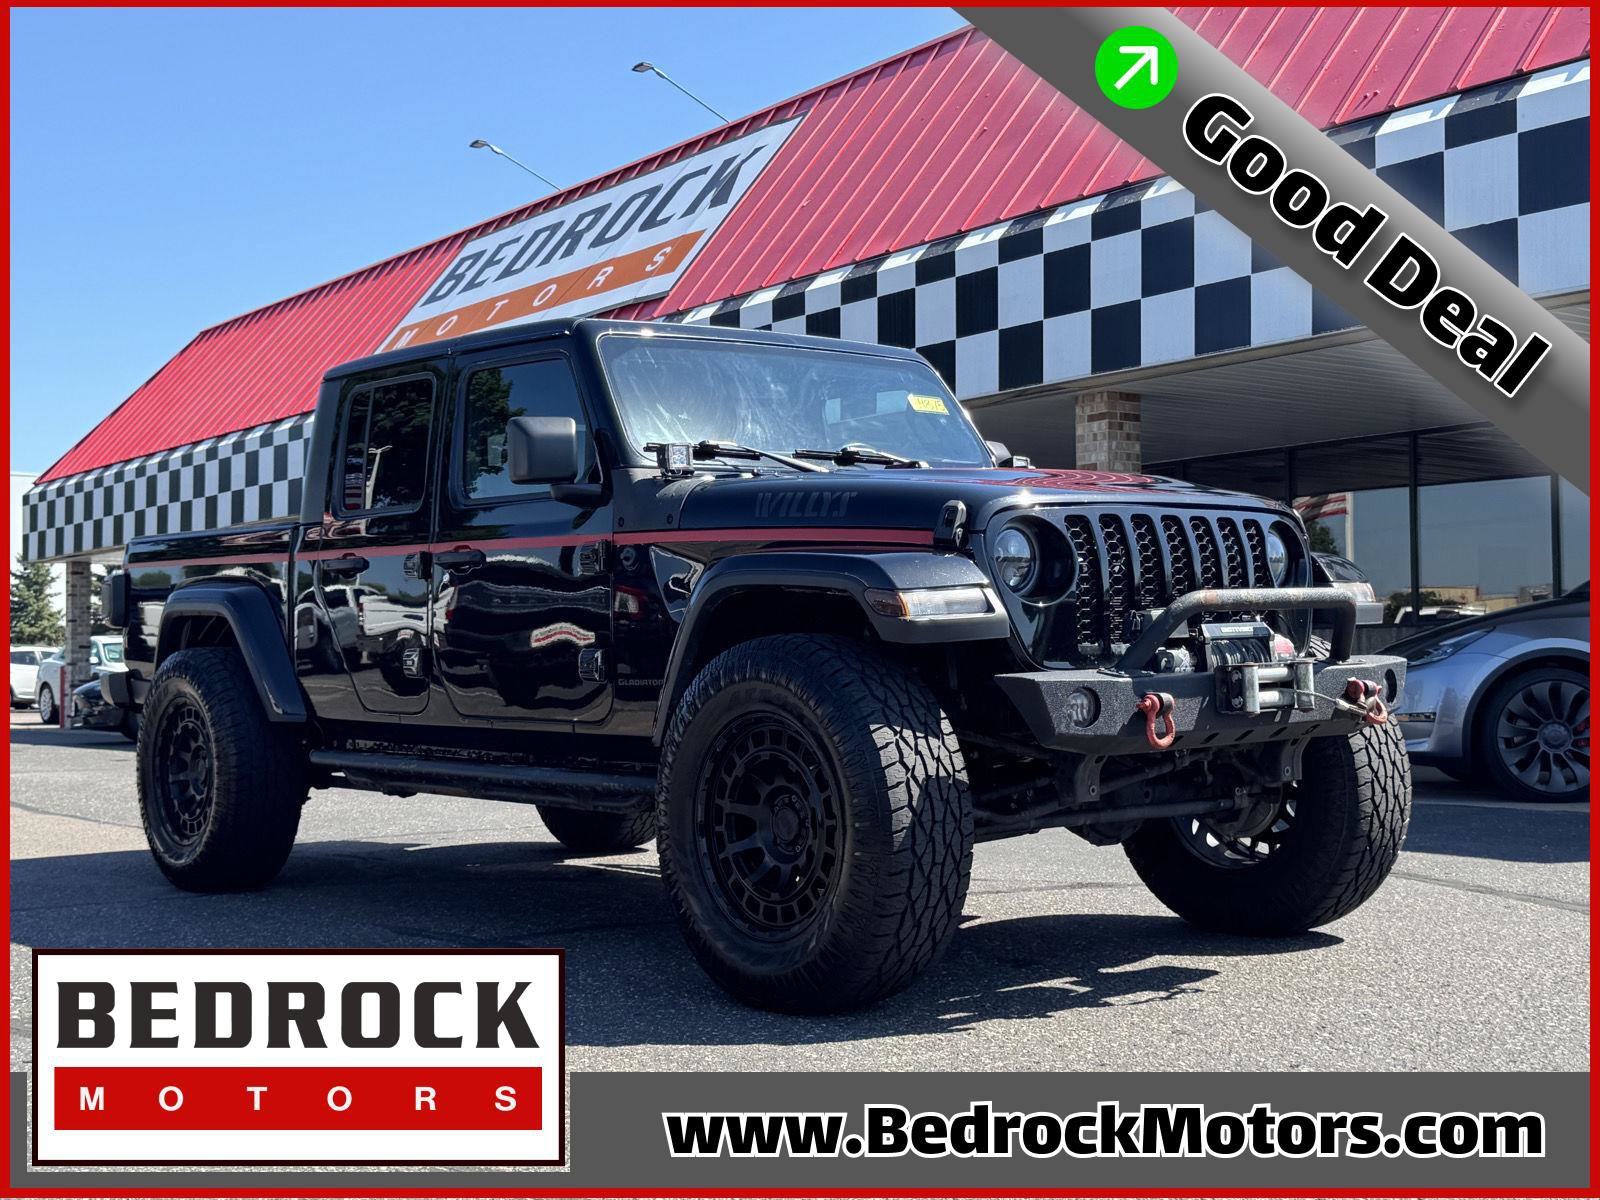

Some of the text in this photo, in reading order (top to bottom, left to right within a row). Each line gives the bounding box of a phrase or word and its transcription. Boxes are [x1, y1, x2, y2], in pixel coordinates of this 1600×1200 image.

[419, 144, 768, 306] BEDROCK
[393, 246, 672, 350] MOTORS
[754, 491, 858, 518] WILLYS
